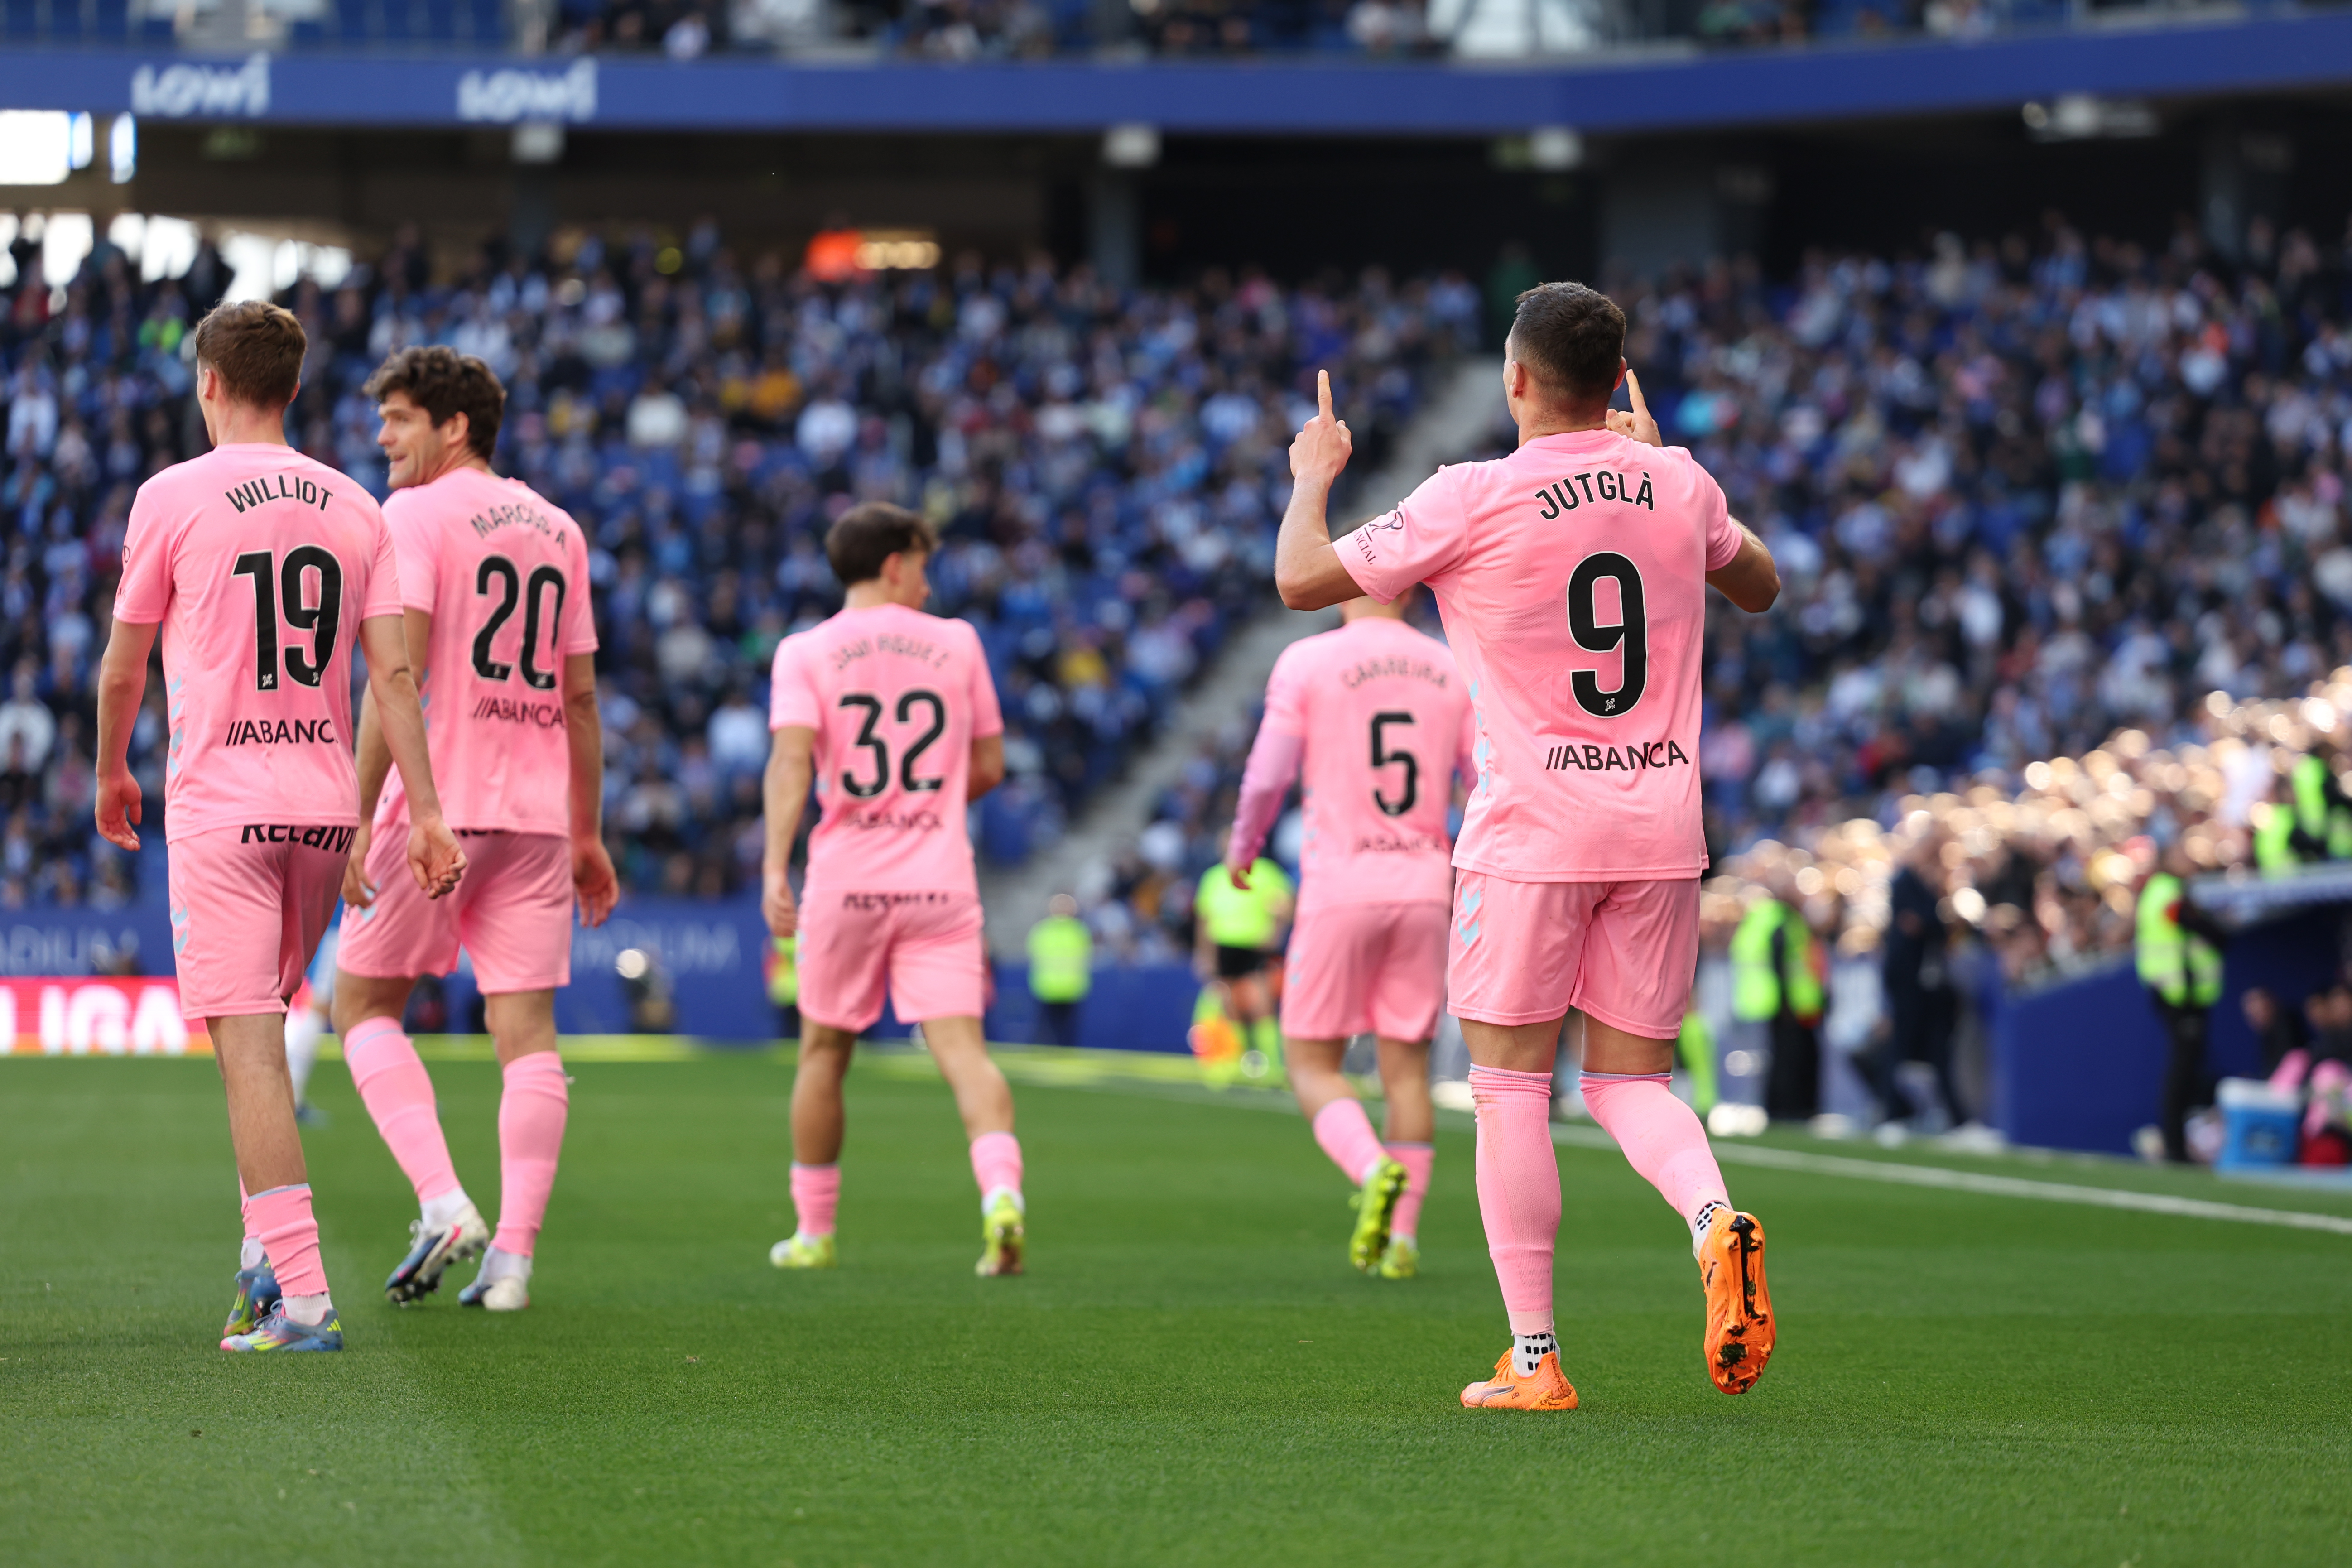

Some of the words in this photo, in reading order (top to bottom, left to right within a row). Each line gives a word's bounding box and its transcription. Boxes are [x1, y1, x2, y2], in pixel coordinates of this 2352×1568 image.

[225, 474, 334, 513] WILLIOT
[1533, 470, 1654, 521] JUTGLÀ
[230, 543, 343, 692] 19
[471, 552, 566, 690] 20
[1566, 550, 1648, 719] 9
[839, 689, 946, 798] 32
[1371, 712, 1417, 817] 5
